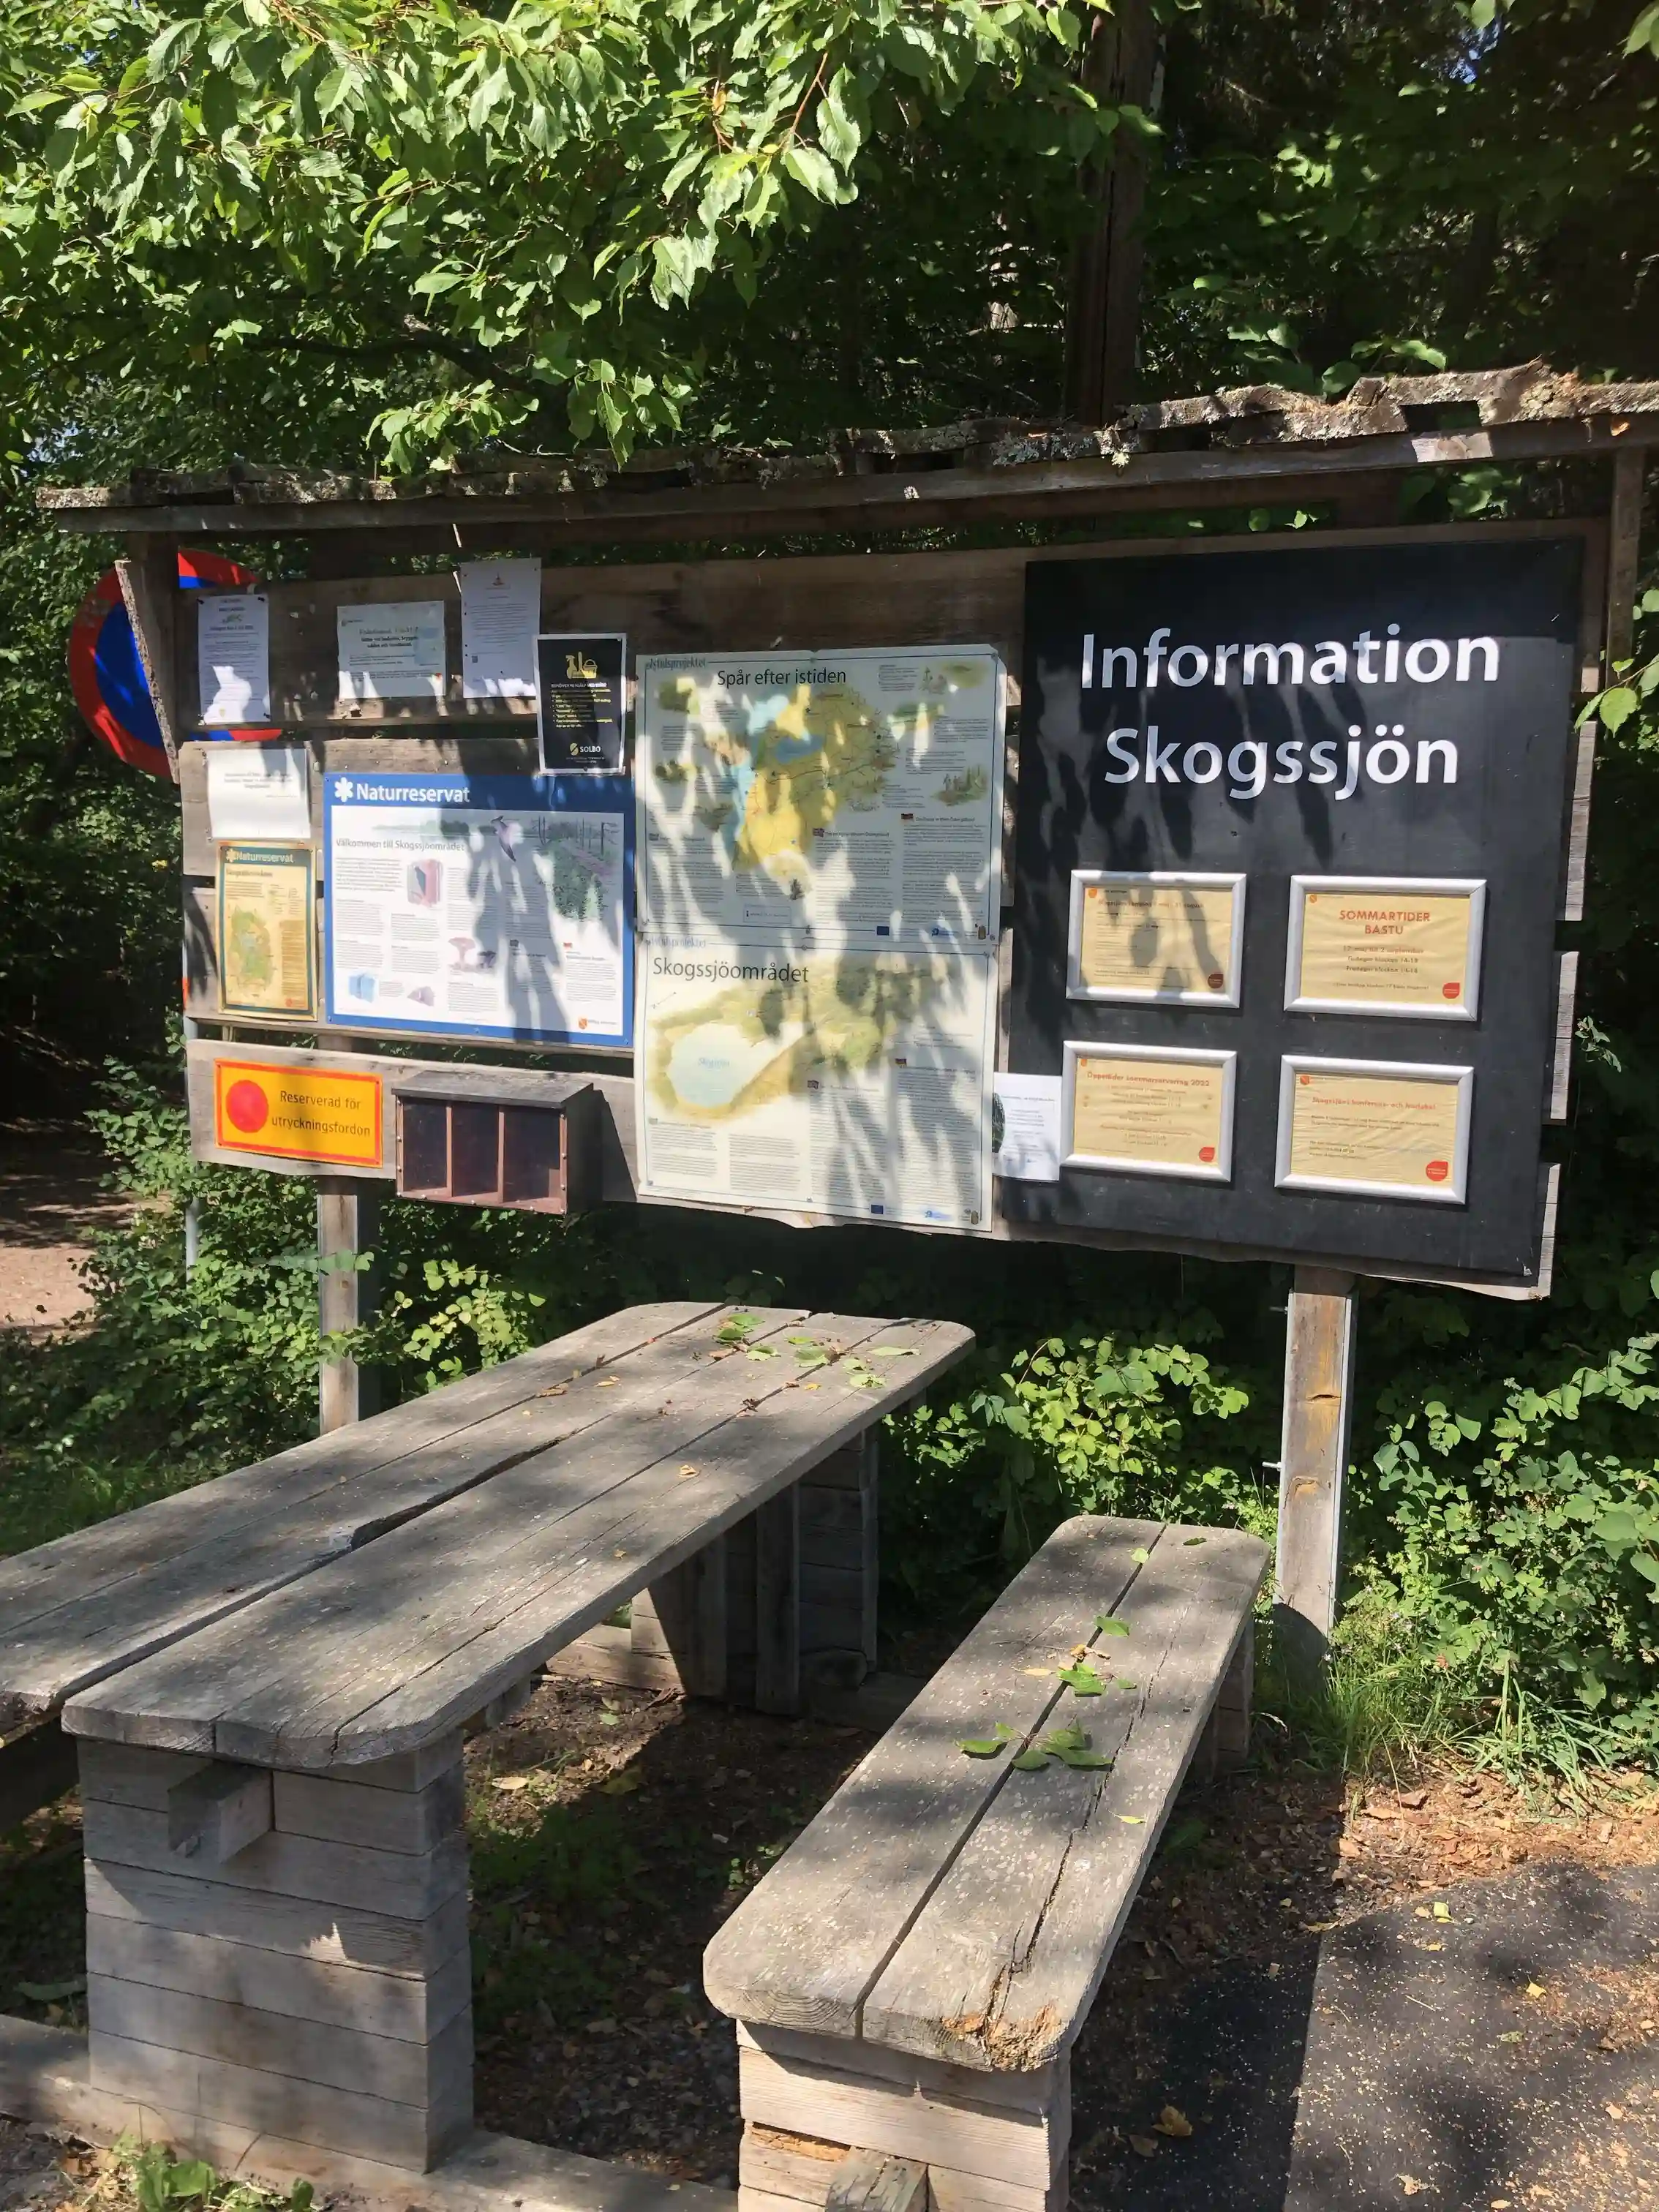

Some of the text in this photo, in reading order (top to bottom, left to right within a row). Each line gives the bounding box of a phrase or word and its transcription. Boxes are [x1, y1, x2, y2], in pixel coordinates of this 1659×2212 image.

[1081, 622, 1500, 689] Information
[717, 667, 846, 689] Spår efter istiden
[1104, 723, 1459, 801] Skogssjön
[356, 782, 470, 803] Naturreservat
[336, 838, 382, 849] Välkommen
[383, 839, 393, 849] till
[236, 851, 294, 864] Naturreservat
[1339, 910, 1431, 922] SOMMARTIDER
[1365, 925, 1404, 936] BASTU
[653, 958, 810, 983] Skogssjöområdet
[1190, 1079, 1210, 1087] 2022
[280, 1090, 361, 1110] Reserverad för
[271, 1116, 371, 1138] utryckningsfordon
